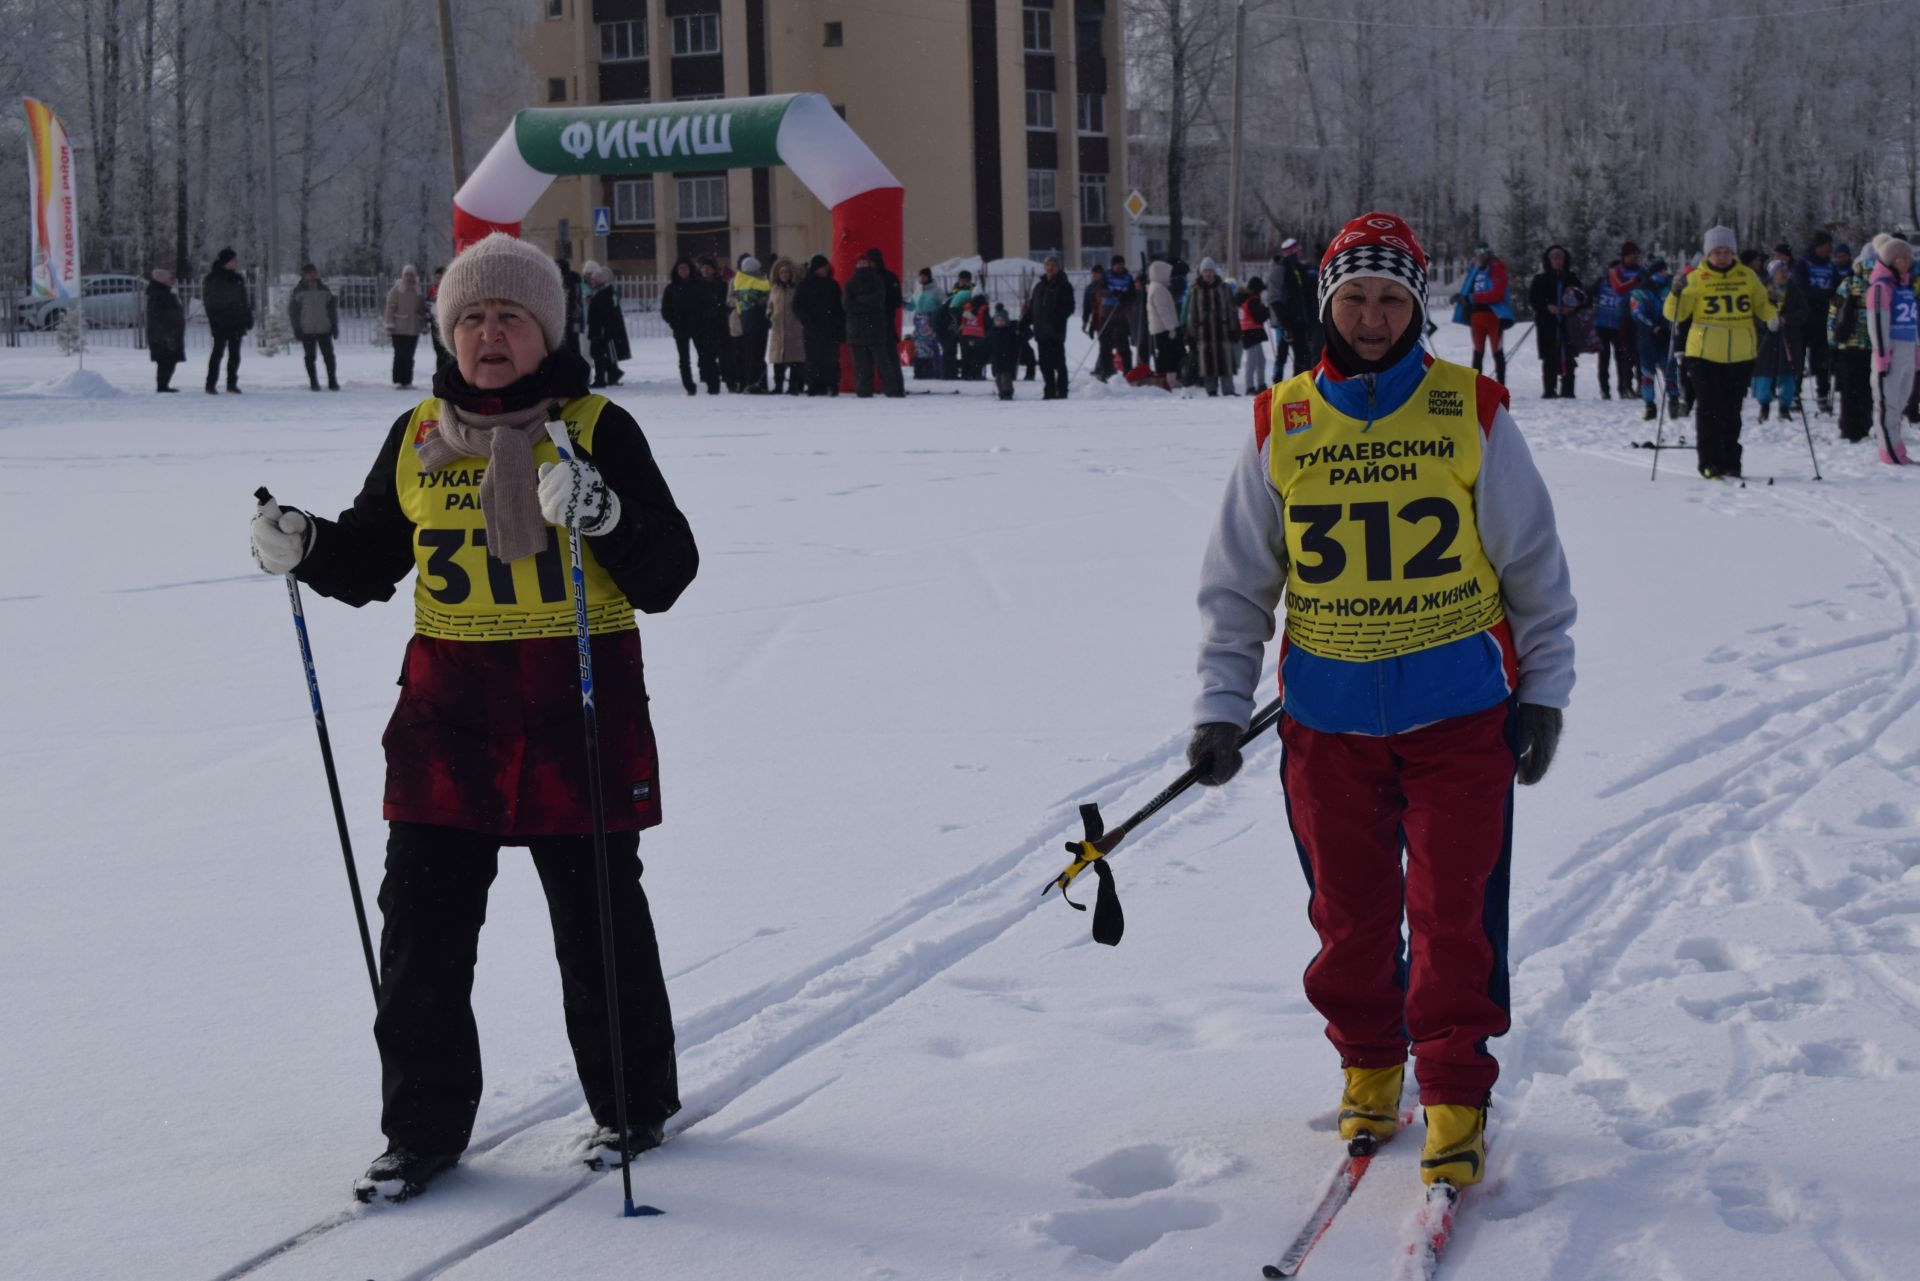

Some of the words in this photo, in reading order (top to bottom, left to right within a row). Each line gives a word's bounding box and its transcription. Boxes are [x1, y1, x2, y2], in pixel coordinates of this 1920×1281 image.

[561, 113, 733, 159] ФИНИШ
[1703, 294, 1751, 314] 316
[1896, 302, 1918, 322] 24
[1428, 399, 1463, 408] НОРМА
[1429, 390, 1458, 399] СПОРТ
[1428, 406, 1463, 416] ЖИЗНИ
[1295, 436, 1454, 469] ТУКАЕВСКИЙ
[417, 469, 485, 489] ТУКАЕ
[1329, 461, 1417, 485] РАЙОН
[1289, 497, 1462, 584] 312
[418, 528, 567, 604] 311
[1336, 596, 1418, 617] НОРМА
[1421, 577, 1482, 612] ЖИЗНИ
